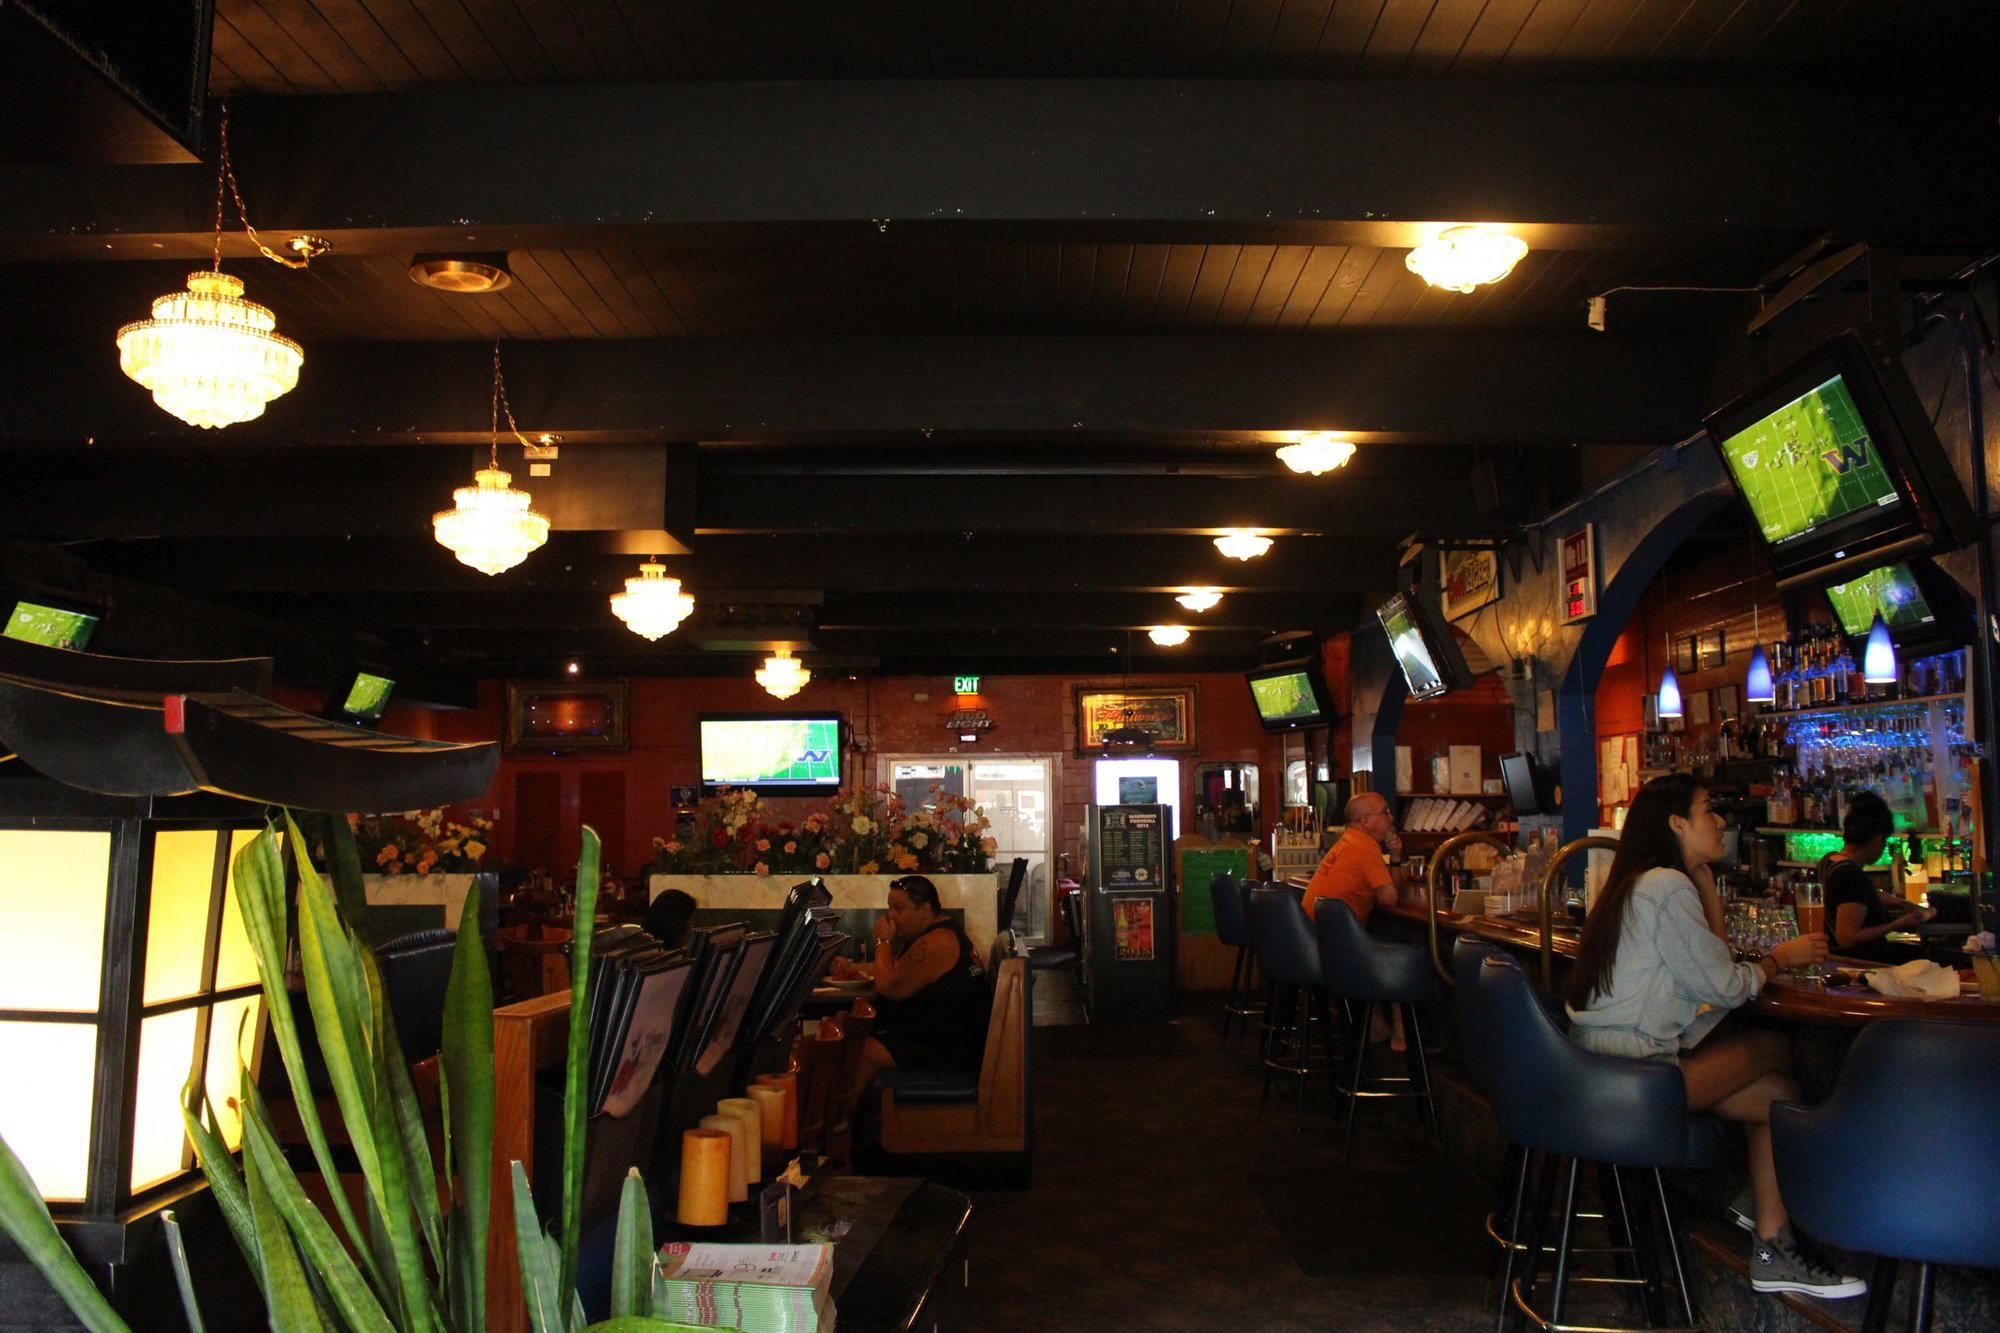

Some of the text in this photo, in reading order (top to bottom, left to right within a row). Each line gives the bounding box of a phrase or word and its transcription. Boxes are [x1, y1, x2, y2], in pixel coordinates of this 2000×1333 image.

[1820, 435, 1870, 475] W
[955, 677, 979, 692] EXIT
[946, 720, 992, 729] LIGHT
